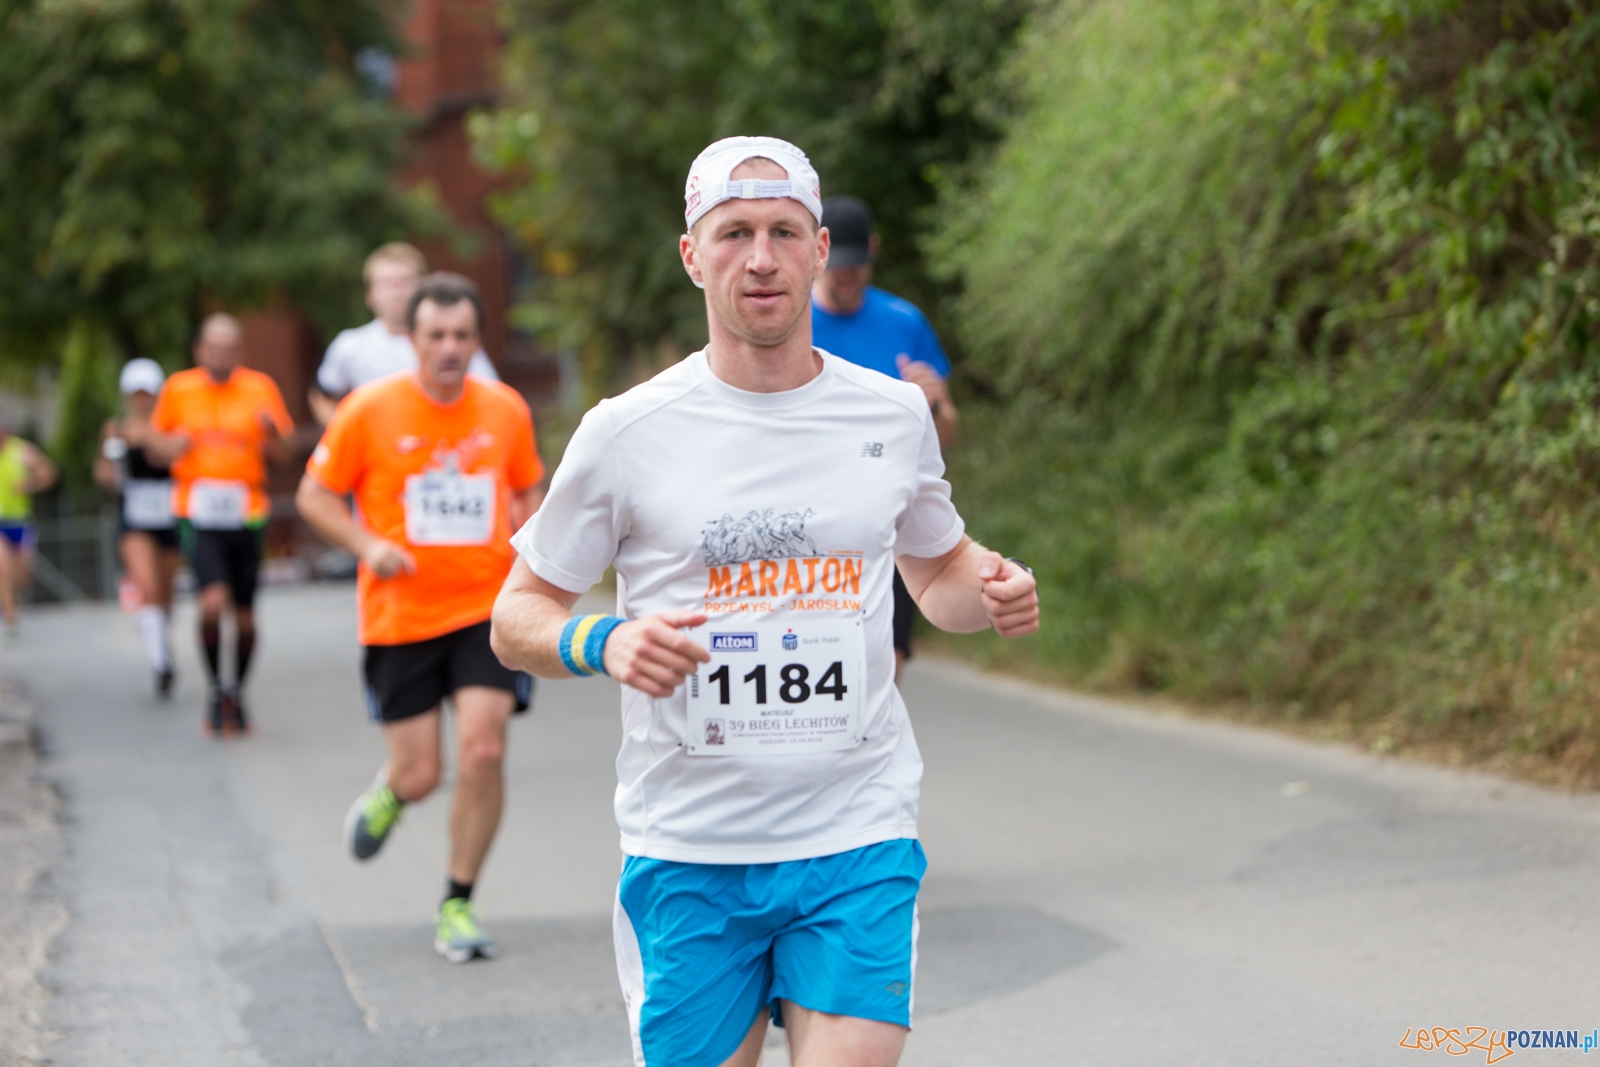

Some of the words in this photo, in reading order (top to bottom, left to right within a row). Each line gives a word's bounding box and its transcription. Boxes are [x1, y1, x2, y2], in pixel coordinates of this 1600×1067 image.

[704, 557, 863, 598] MARATON
[705, 600, 775, 613] PRZEMYŚL
[789, 598, 861, 612] JAROSŁAW
[708, 660, 848, 705] 1184
[729, 719, 745, 732] 39
[749, 719, 781, 731] BIEG
[785, 713, 850, 730] LECHITÓW
[760, 709, 795, 717] MATEUSZ
